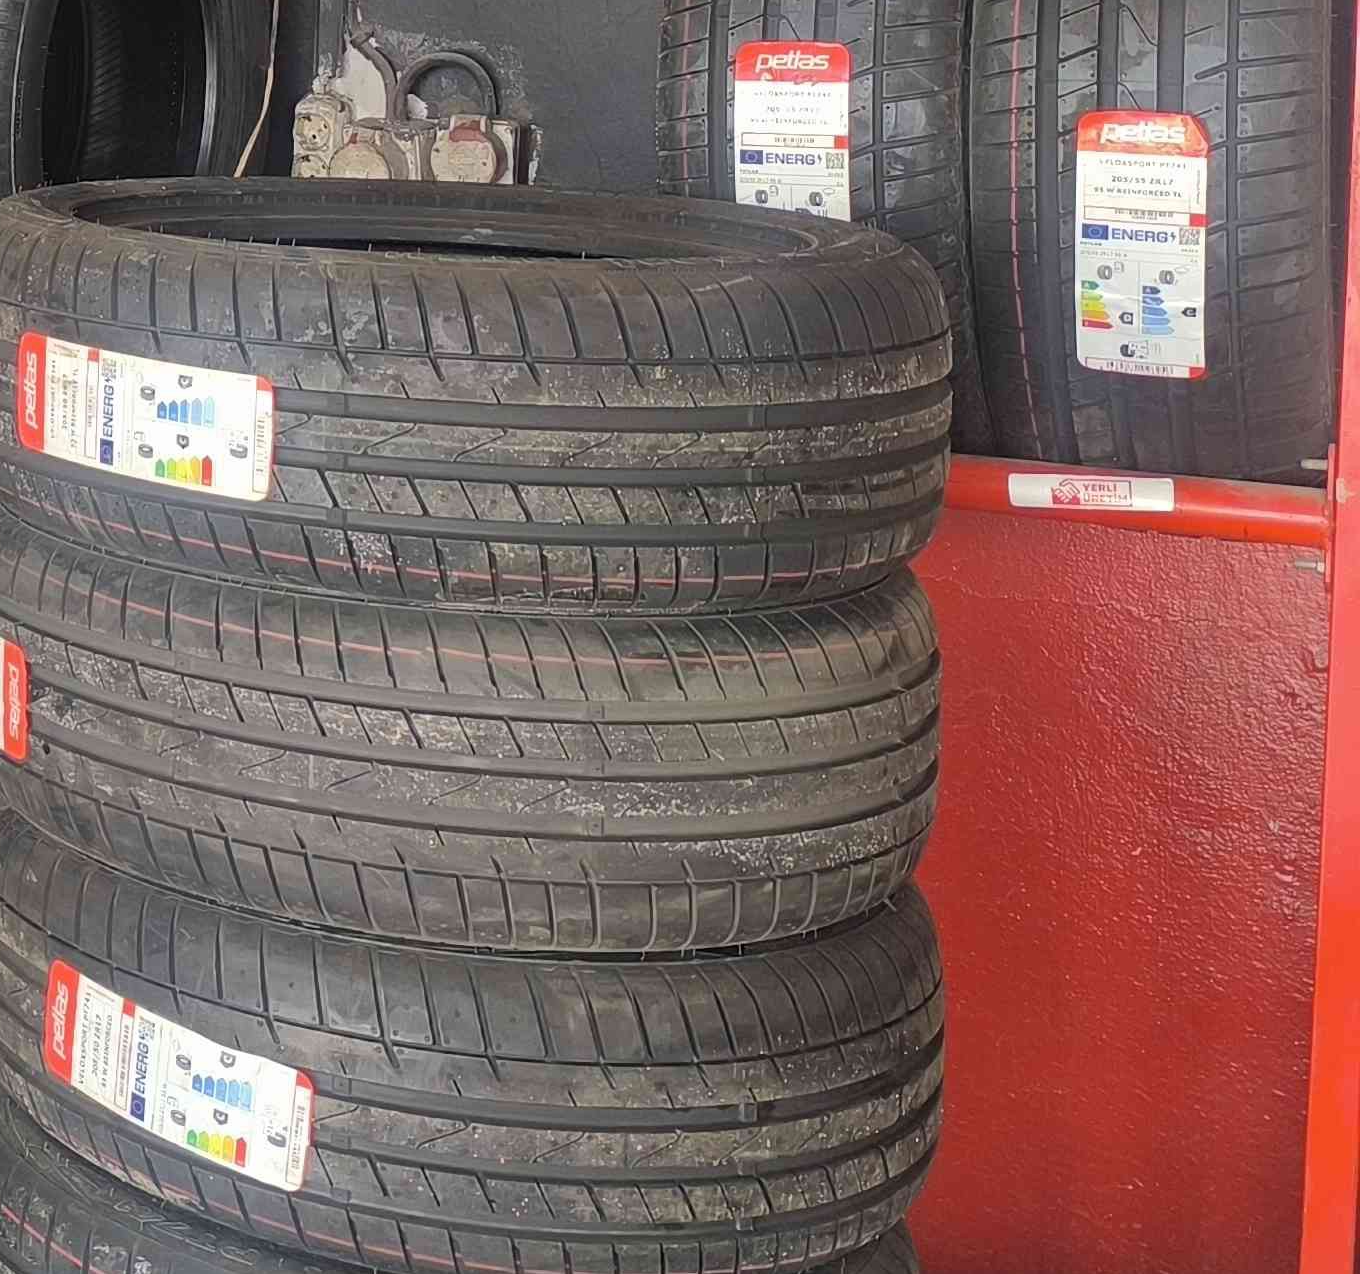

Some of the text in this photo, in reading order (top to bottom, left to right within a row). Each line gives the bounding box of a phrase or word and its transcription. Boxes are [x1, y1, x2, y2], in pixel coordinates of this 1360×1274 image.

[754, 49, 831, 72] petlas
[1099, 122, 1186, 145] petlas
[765, 153, 816, 166] ENERG
[1111, 228, 1169, 243] ENERG
[24, 351, 39, 430] petlas
[102, 384, 114, 438] ENERG
[1083, 482, 1117, 493] YERLİ
[8, 661, 22, 741] petlas
[51, 979, 69, 1061] petlas
[135, 1041, 149, 1095] ENERG
